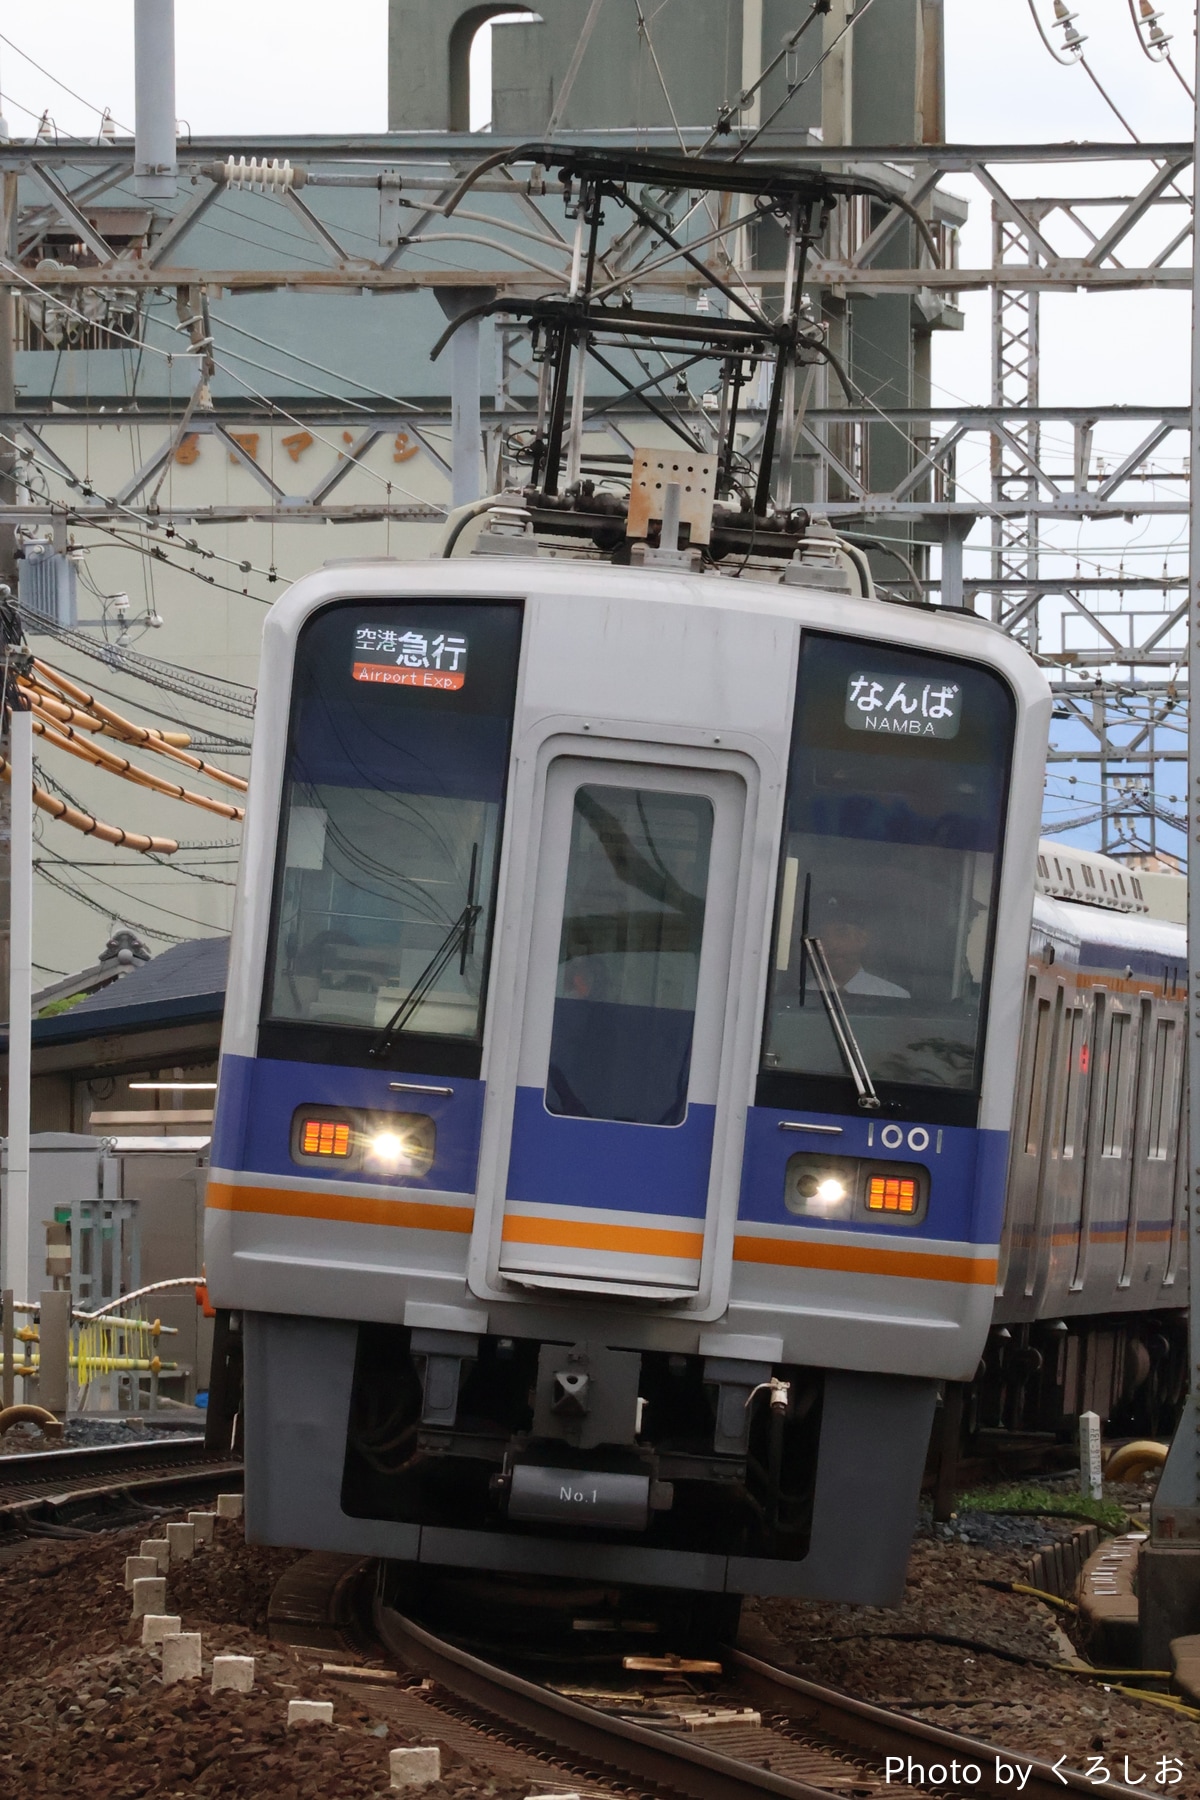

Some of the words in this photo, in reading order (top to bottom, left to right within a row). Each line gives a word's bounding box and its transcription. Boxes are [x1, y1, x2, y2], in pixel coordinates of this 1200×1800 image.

[355, 628, 467, 671] 空港急行
[359, 667, 417, 685] Airport
[423, 673, 457, 689] Exp.
[850, 675, 959, 718] なんば
[865, 716, 935, 735] NAMBA
[868, 1122, 943, 1154] 1001
[559, 1486, 597, 1503] No.1
